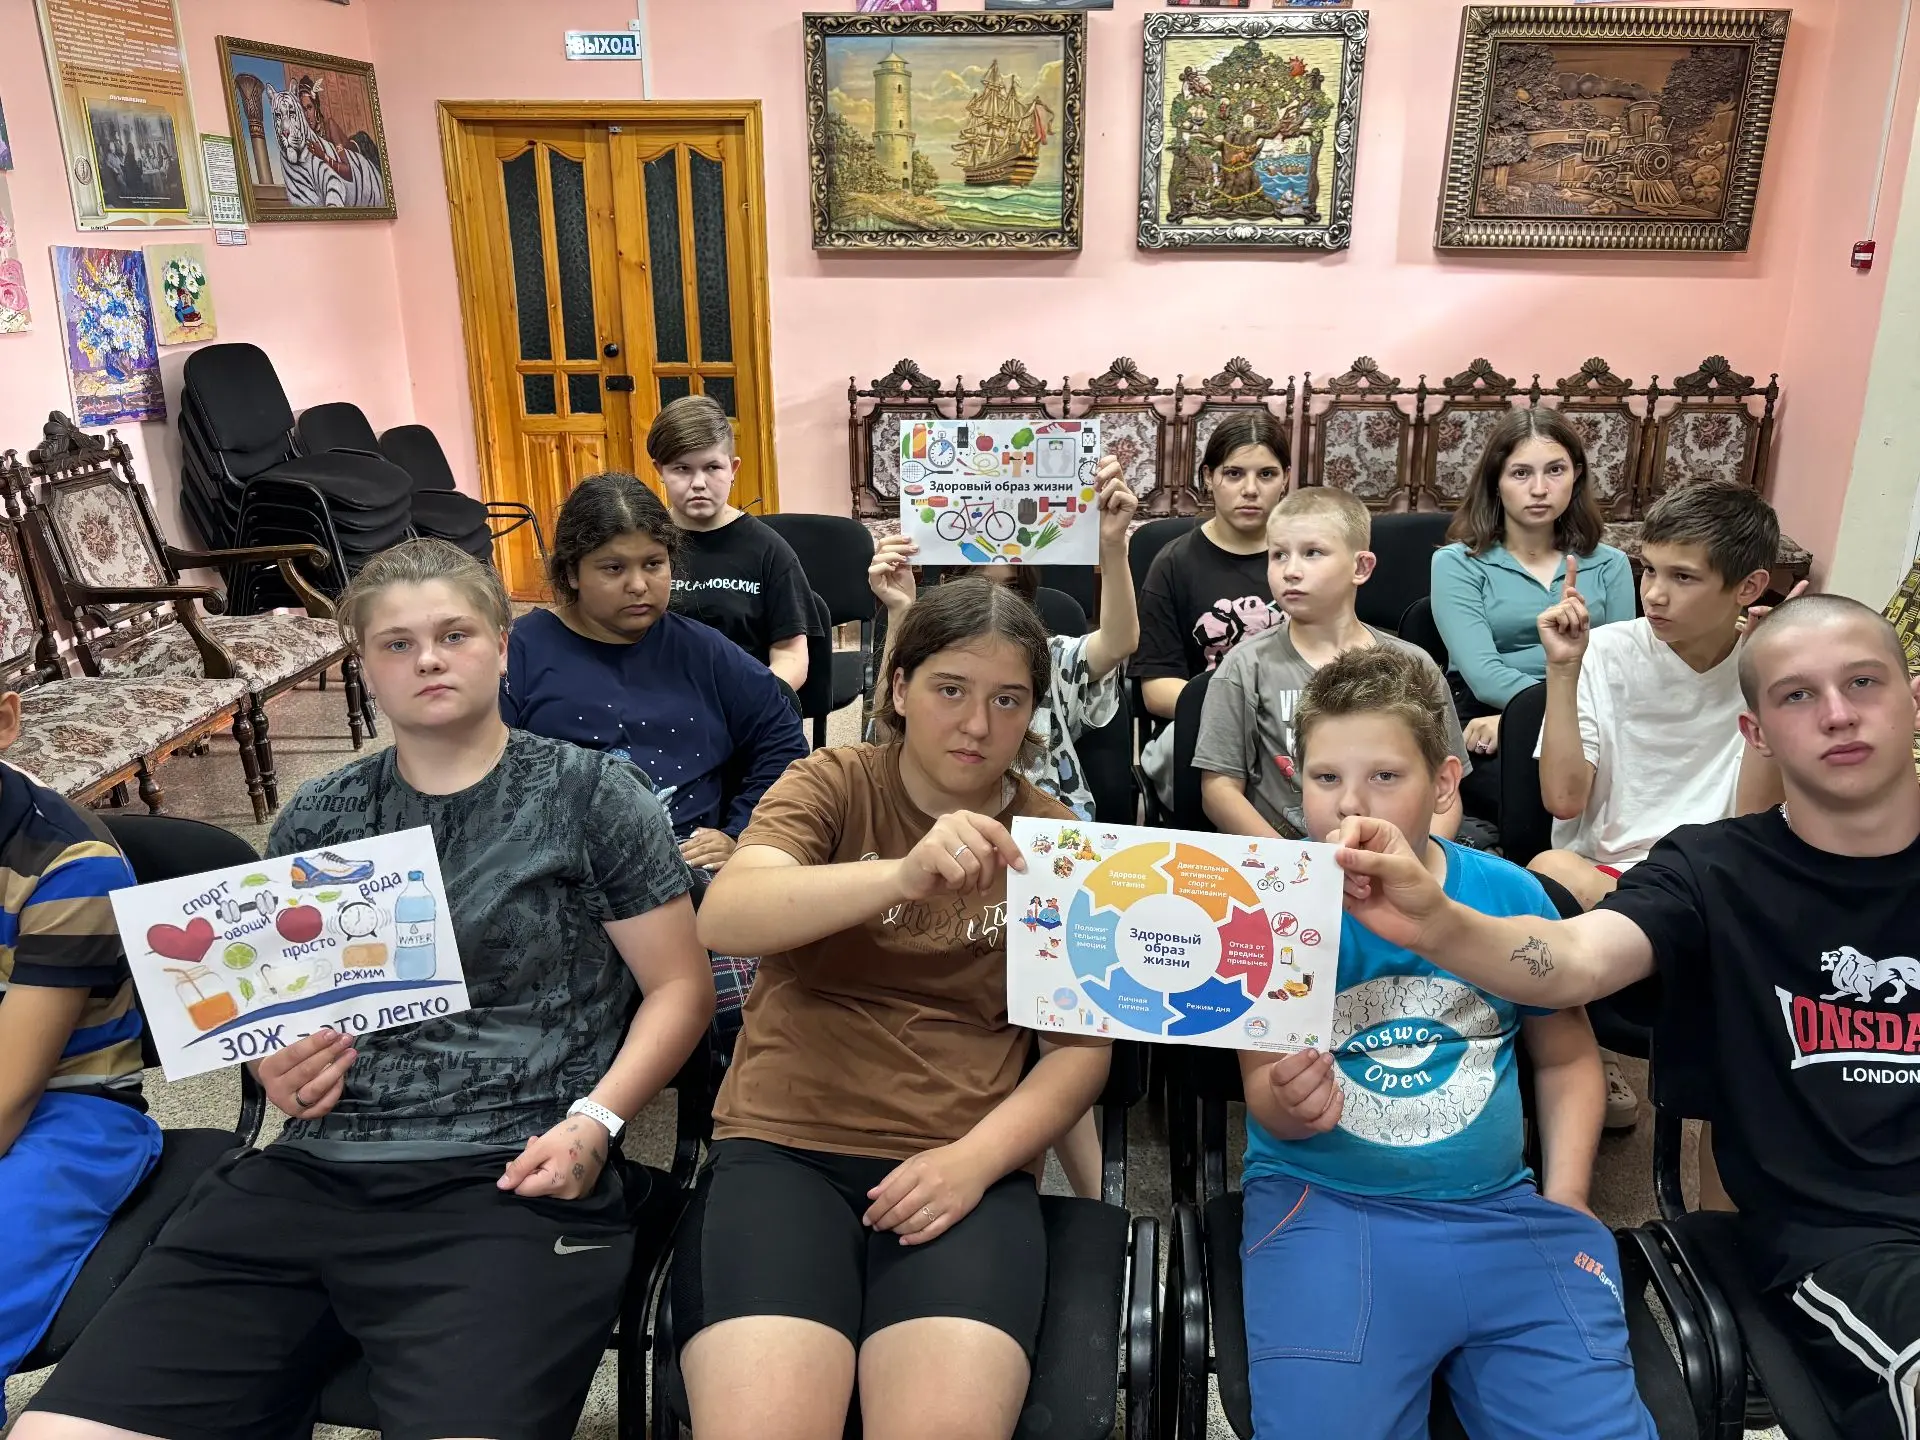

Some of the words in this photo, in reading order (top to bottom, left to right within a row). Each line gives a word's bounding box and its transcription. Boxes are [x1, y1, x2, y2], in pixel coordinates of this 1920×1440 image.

[570, 36, 634, 54] ВЫХОД
[930, 480, 991, 493] Здоровый
[994, 480, 1030, 493] образ
[1033, 482, 1073, 492] жизни
[1177, 861, 1230, 873] Двигательная
[1108, 870, 1147, 880] Здоровое
[359, 872, 402, 900] вода
[1111, 880, 1146, 889] питание
[1188, 880, 1209, 889] спорт
[182, 881, 229, 915] спорт
[1179, 887, 1228, 898] закаливание
[224, 914, 272, 940] овощи
[1074, 923, 1109, 933] Положи-
[400, 934, 433, 944] WATER
[1074, 932, 1107, 942] тельные
[1129, 928, 1202, 945] Здоровый
[282, 938, 336, 960] просто
[1144, 942, 1186, 956] образ
[1229, 941, 1254, 950] Отказ
[1228, 950, 1265, 959] вредных
[1143, 955, 1191, 969] жизни
[1226, 958, 1268, 967] привычек
[333, 968, 385, 986] режим
[1118, 995, 1148, 1004] Личная
[1118, 1004, 1150, 1012] гигиена
[1186, 1002, 1214, 1011] Режим
[218, 1024, 286, 1061] ЗОЖ
[376, 996, 450, 1029] легко
[1364, 1064, 1432, 1092] Open
[1842, 1066, 1920, 1084] LONDON
